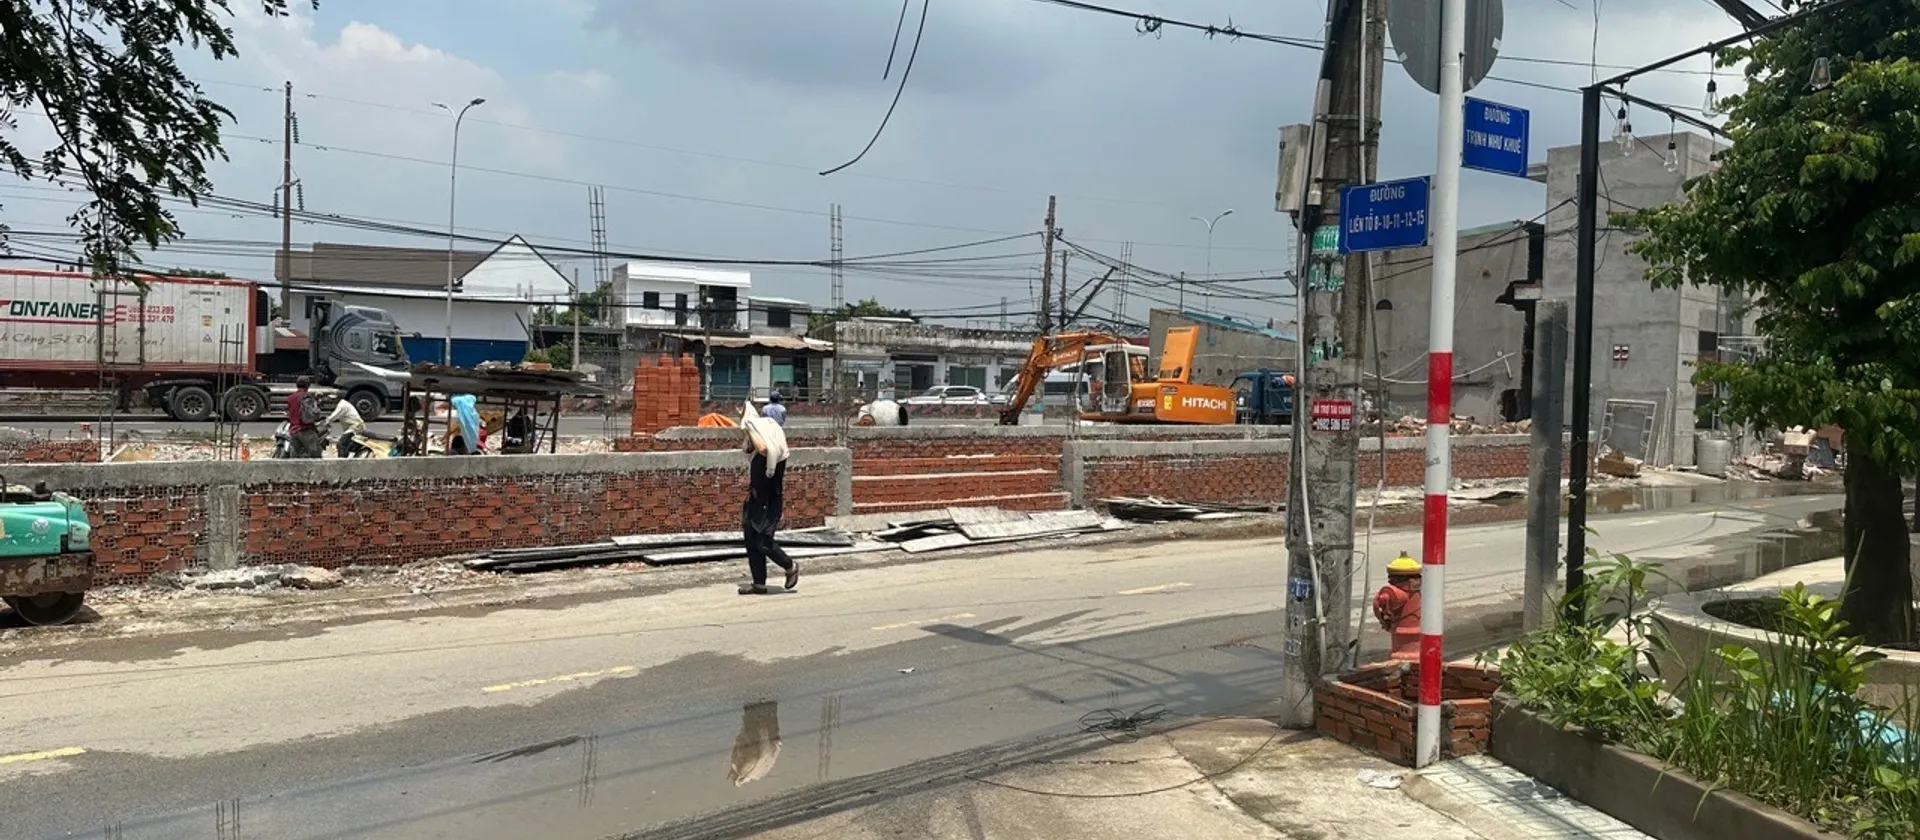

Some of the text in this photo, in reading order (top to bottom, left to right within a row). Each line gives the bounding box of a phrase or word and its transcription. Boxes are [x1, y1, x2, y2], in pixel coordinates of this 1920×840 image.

[1484, 105, 1510, 125] ĐƯỜNG
[1466, 129, 1487, 147] TRỊNH
[1488, 133, 1503, 150] NHƯ
[1370, 184, 1405, 202] ĐƯỜNG
[1349, 215, 1364, 233] LIÊN
[1365, 208, 1374, 231] TỔ
[1, 299, 104, 319] ONTAINER
[1182, 397, 1227, 411] HITACHI
